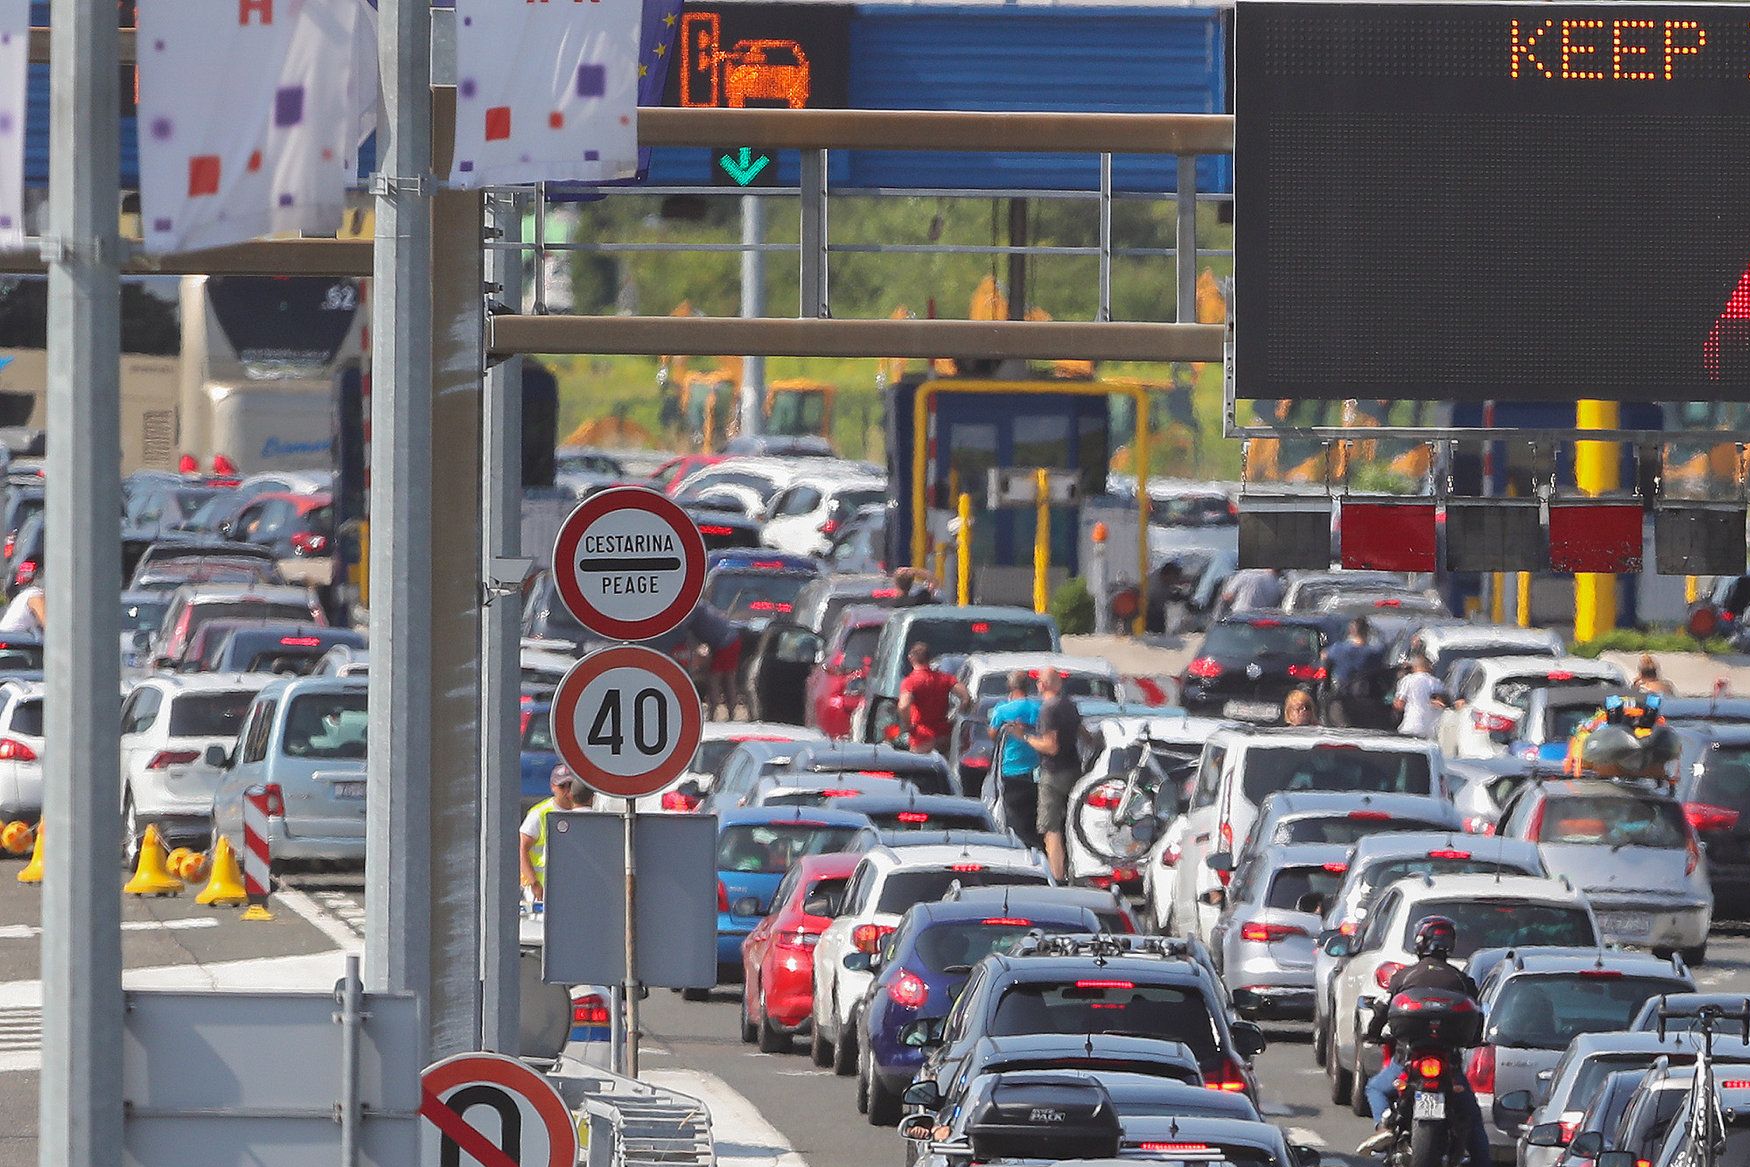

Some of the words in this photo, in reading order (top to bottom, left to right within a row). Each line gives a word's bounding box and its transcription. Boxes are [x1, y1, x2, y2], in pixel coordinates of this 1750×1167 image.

[1510, 19, 1706, 80] KEEP
[585, 534, 674, 553] CESTARINA
[602, 575, 659, 595] PEAGE
[587, 687, 668, 756] 40
